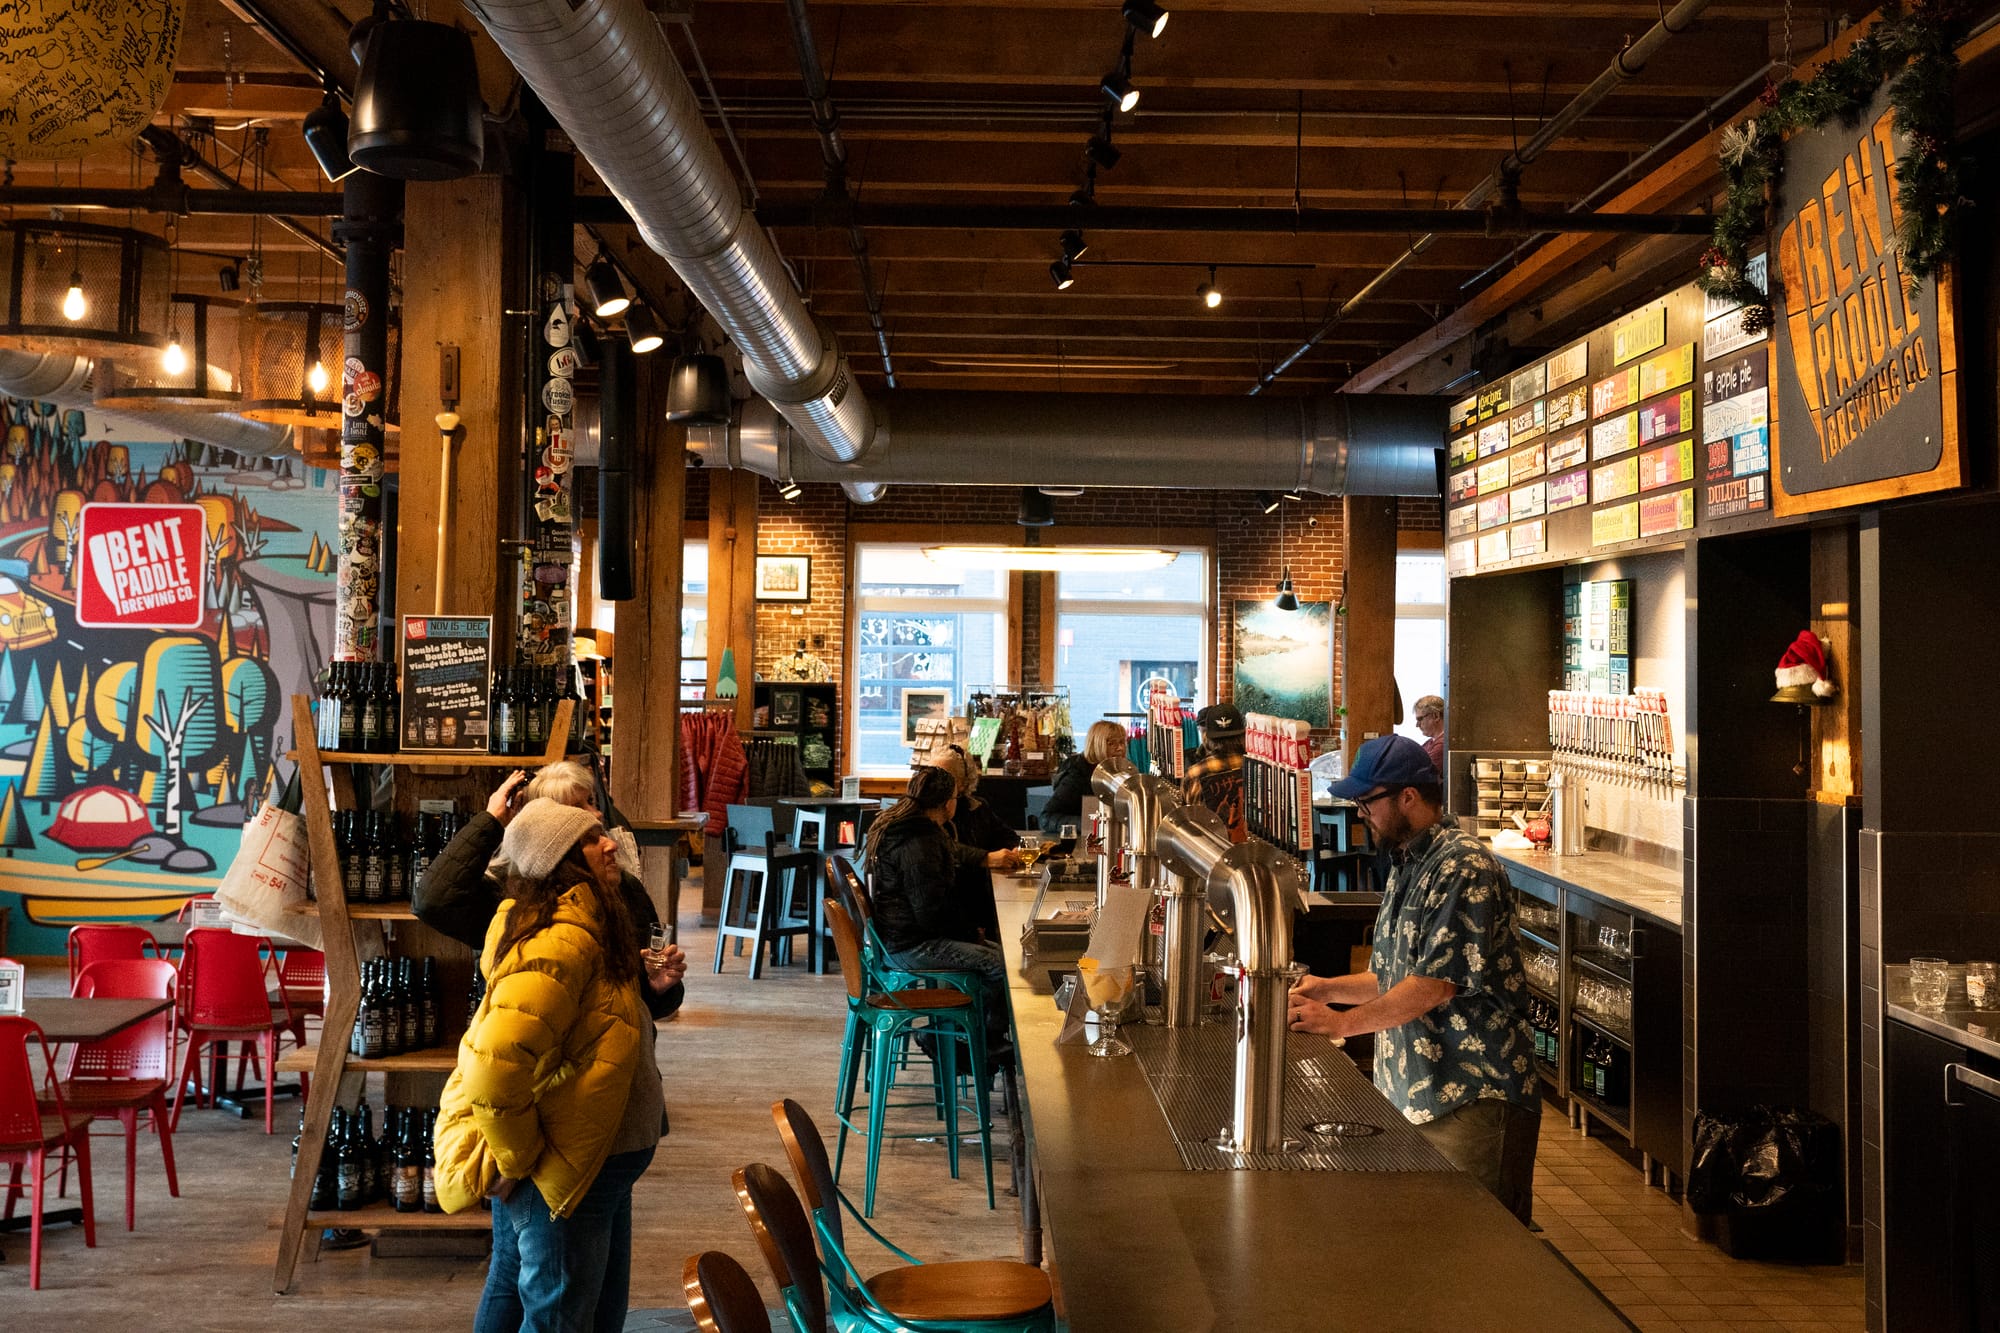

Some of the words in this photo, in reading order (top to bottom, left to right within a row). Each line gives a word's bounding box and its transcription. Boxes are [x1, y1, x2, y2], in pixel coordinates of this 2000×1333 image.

[1799, 105, 1901, 322] BENT
[1814, 252, 1921, 410] PADDLE
[1716, 367, 1737, 400] apple
[1740, 359, 1752, 392] pie
[1824, 358, 1900, 458] BREWING
[1903, 334, 1933, 394] CO.
[1708, 440, 1729, 470] 1919
[1708, 478, 1747, 505] DULUTH
[1709, 503, 1725, 517] COFFEE
[1726, 499, 1747, 514] COMPANY
[106, 516, 184, 571] BENT
[115, 557, 190, 600] PADDLE
[120, 591, 176, 615] BREWING
[177, 585, 197, 601] CO.
[430, 621, 448, 631] NOV
[450, 622, 459, 631] 15
[466, 622, 484, 631] DEC
[407, 645, 440, 656] Double
[441, 641, 462, 651] Shot
[409, 660, 439, 670] Vintage
[439, 657, 463, 667] Cellar
[463, 653, 487, 663] Sales!
[425, 650, 457, 661] Double
[458, 646, 486, 657] Black
[269, 876, 288, 892] 541
